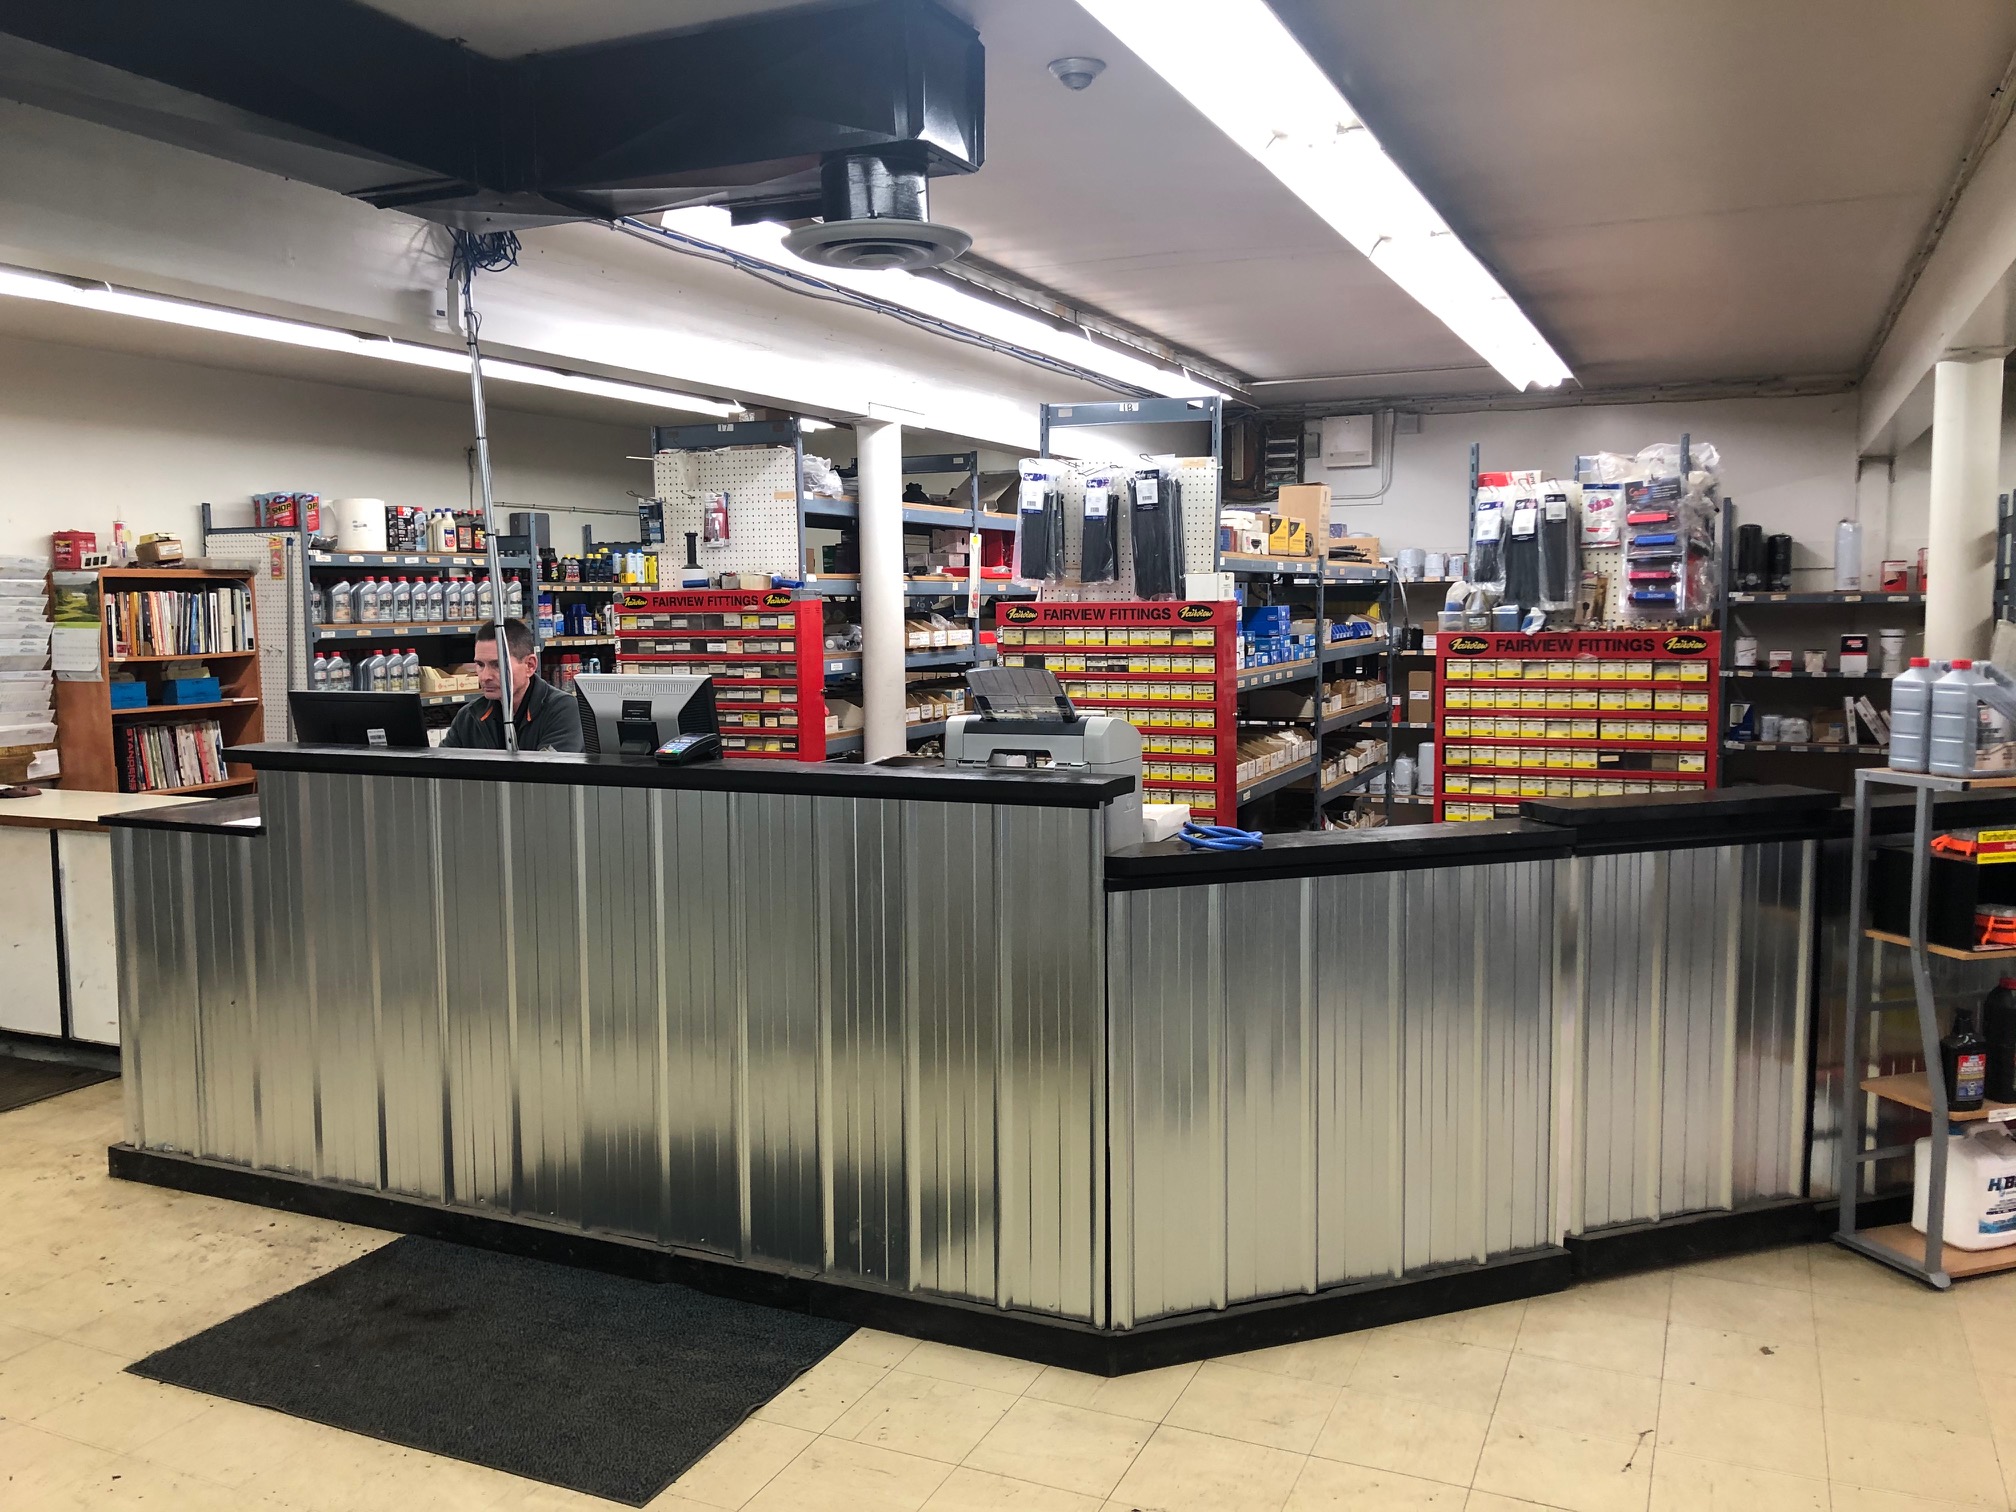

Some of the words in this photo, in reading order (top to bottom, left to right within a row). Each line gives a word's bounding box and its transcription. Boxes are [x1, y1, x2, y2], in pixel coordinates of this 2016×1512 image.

[271, 503, 292, 514] SHOP
[652, 596, 704, 607] FAIRVIEW
[707, 595, 758, 607] FITTINGS
[765, 594, 792, 606] Fairview
[1007, 607, 1038, 619] Fairview
[1043, 608, 1105, 620] FAIRVIEW
[1109, 607, 1171, 620] FITTINGS
[1179, 606, 1213, 618] Fairview
[1450, 638, 1488, 651] Fairview
[1496, 638, 1573, 652] FAIRVIEW
[1578, 638, 1655, 652] FITTINGS
[1664, 637, 1707, 650] Fairview
[126, 728, 137, 791] STANDENS
